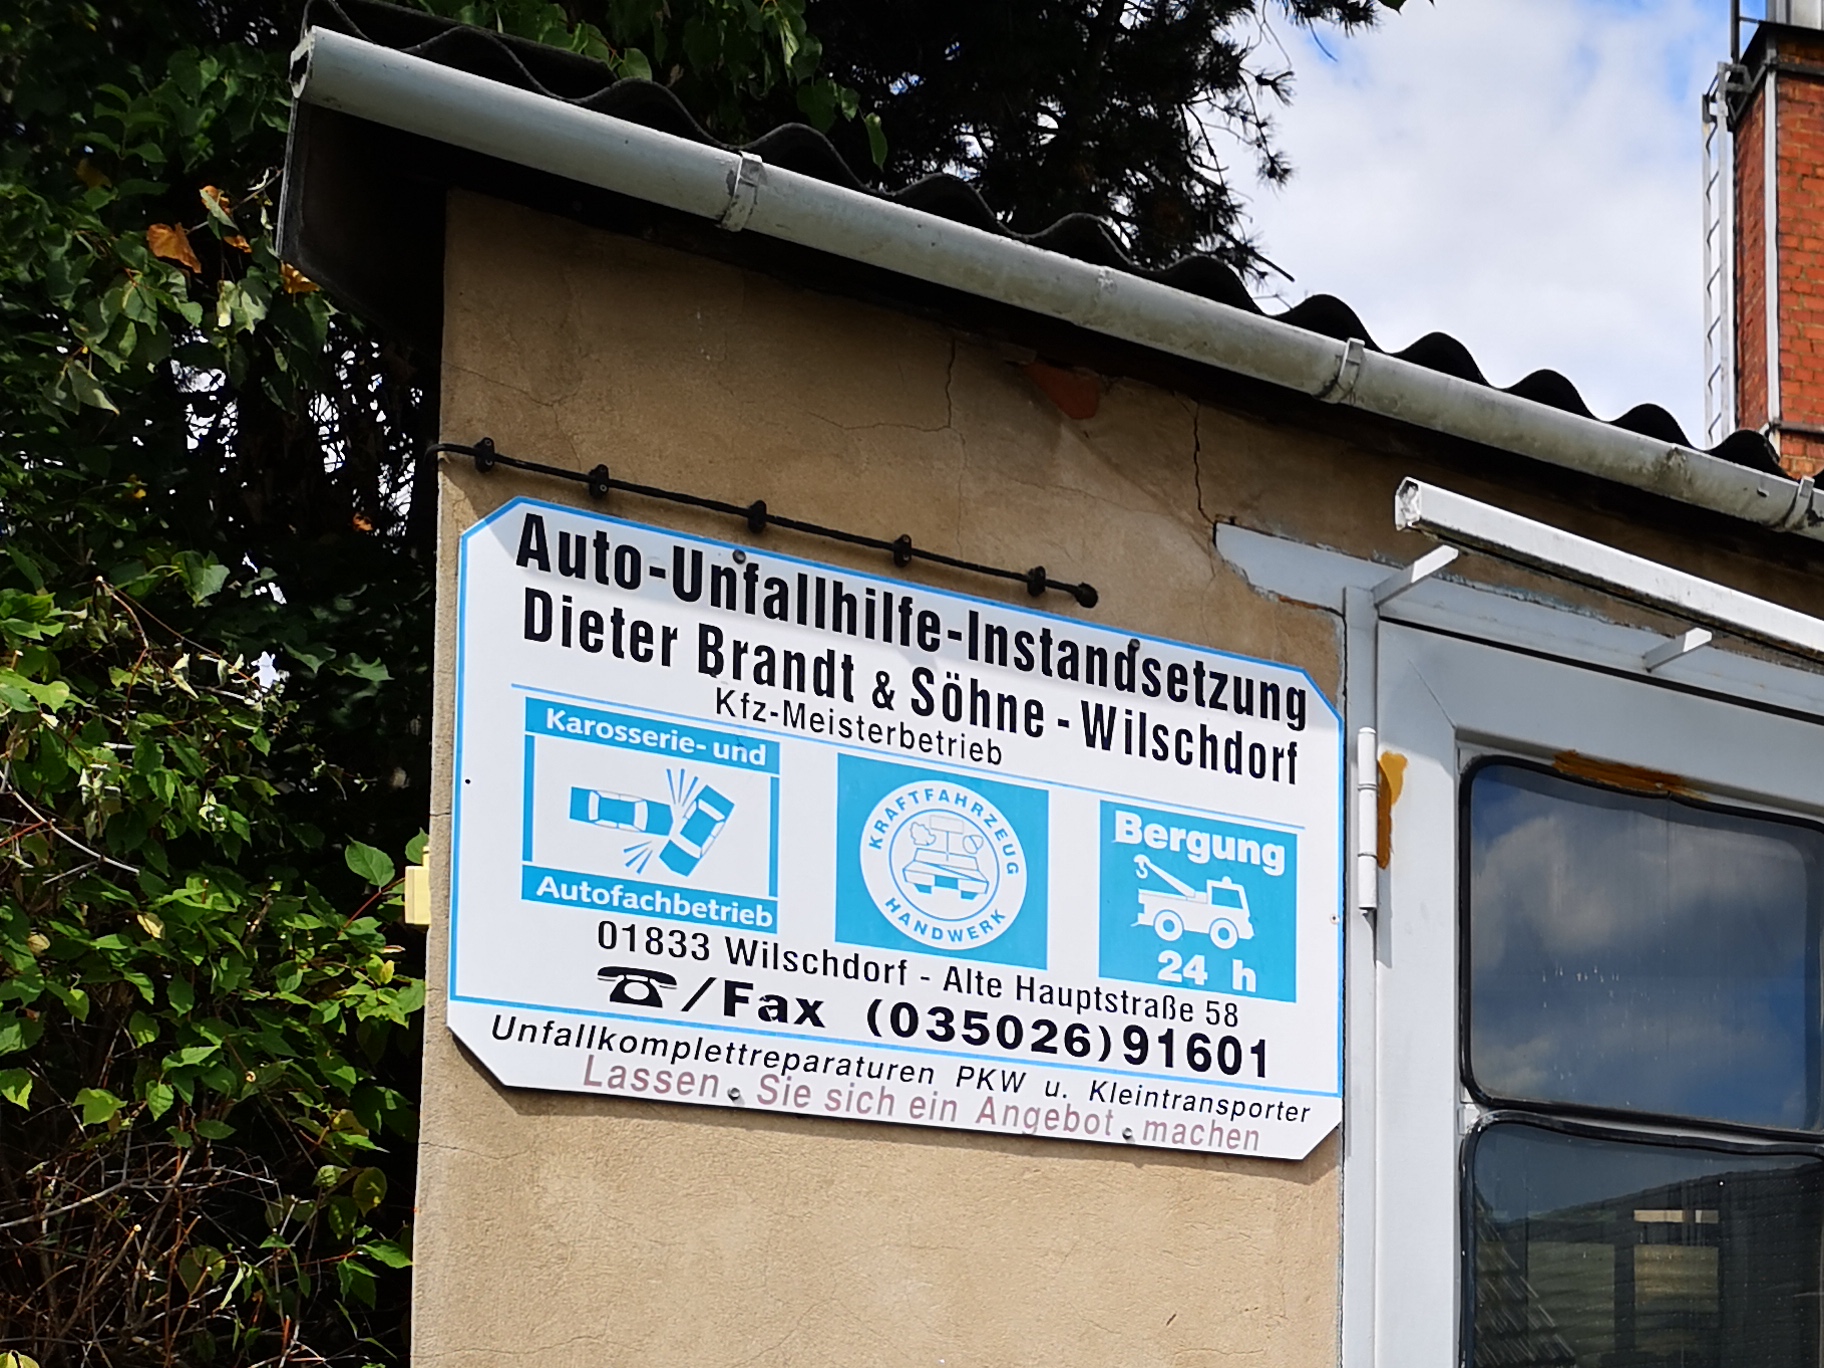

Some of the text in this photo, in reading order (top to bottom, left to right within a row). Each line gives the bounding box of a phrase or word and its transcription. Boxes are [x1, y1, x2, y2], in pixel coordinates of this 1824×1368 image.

[516, 512, 1307, 731] Auto-Unfallhilfe-Instandsetzung
[523, 586, 679, 668] Dieter
[697, 622, 855, 703] Brandt
[871, 670, 896, 711] &
[910, 666, 1045, 738] Söhne
[1081, 699, 1299, 786] Wilschdorf
[715, 686, 1003, 766] Kfz-Meisterbetrieb
[545, 707, 767, 767] Karosserie- und
[868, 787, 1020, 875] KRAFTFAHRZEUG
[1112, 809, 1286, 877] Bergung
[535, 875, 774, 928] Autofachbetrieb
[884, 897, 1007, 943] HANDWERK
[598, 920, 710, 962] 01833
[724, 935, 908, 987] Wilschdorf
[943, 965, 1003, 999] Alte
[1015, 974, 1194, 1024] Hauptstraße
[1205, 1000, 1239, 1028] 58
[1157, 949, 1257, 993] 24 h
[491, 1013, 1312, 1124] Unfallkomplettreparaturen PKW u. Kleintransporter
[583, 1053, 1261, 1152] Lassen Sie sich ein Angebot machen
